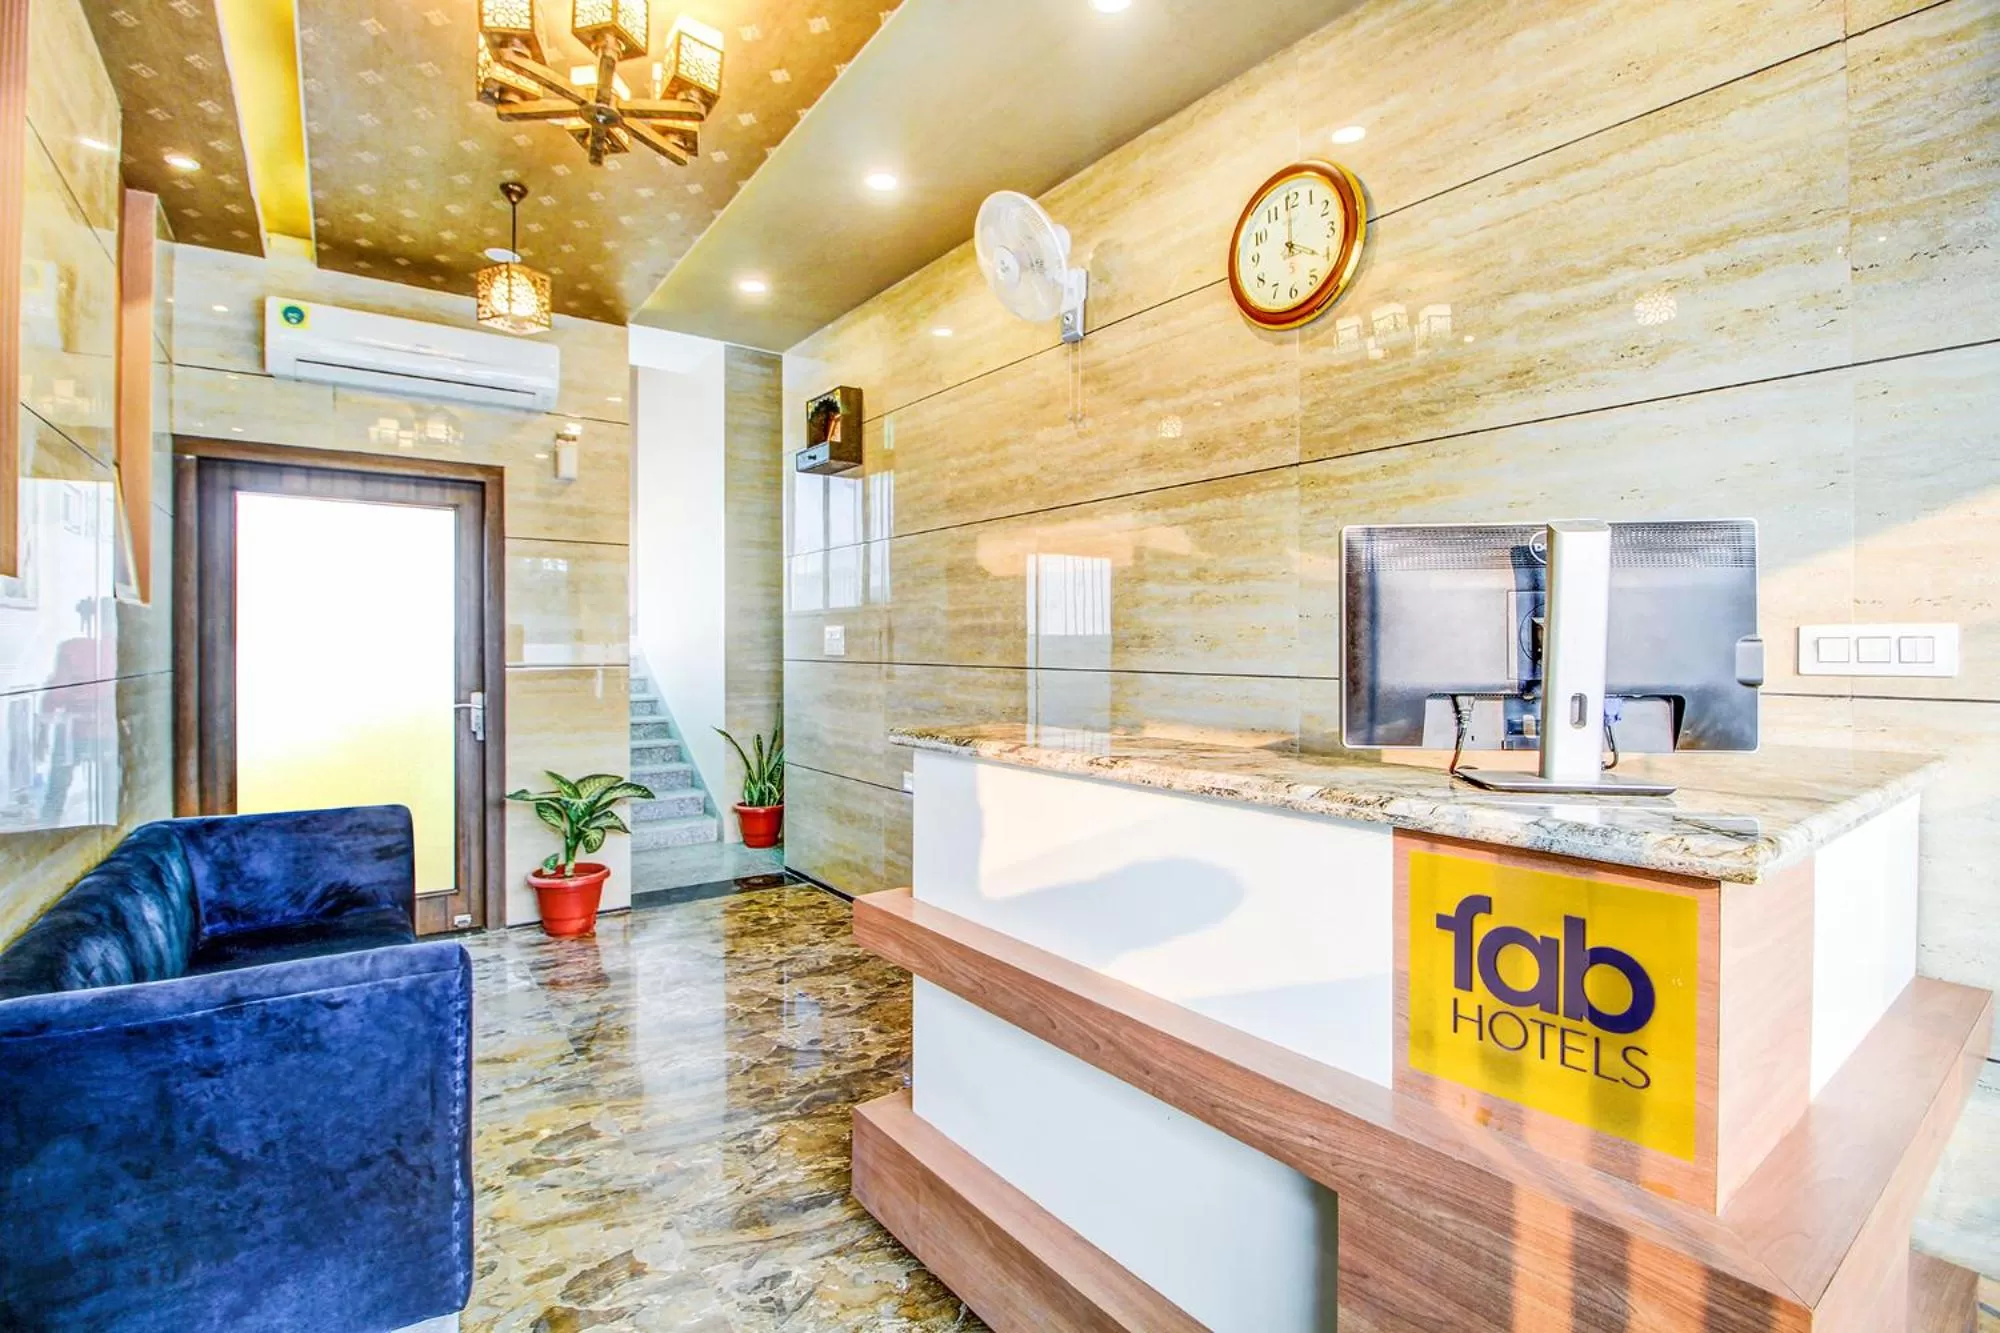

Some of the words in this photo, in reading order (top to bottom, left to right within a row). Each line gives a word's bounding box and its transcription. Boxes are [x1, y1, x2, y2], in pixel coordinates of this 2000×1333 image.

[1284, 191, 1299, 212] 12
[1308, 189, 1313, 205] 1
[1267, 206, 1278, 224] 11
[1320, 199, 1330, 218] 2
[1255, 228, 1268, 247] 10
[1325, 221, 1336, 239] 3
[1251, 252, 1260, 270] 9
[1322, 245, 1330, 262] 4
[1256, 271, 1266, 289] 8
[1308, 268, 1318, 286] 5
[1271, 282, 1280, 300] 7
[1289, 283, 1298, 299] 6
[1436, 894, 1656, 1035] fab
[1453, 998, 1651, 1089] HOTELS
